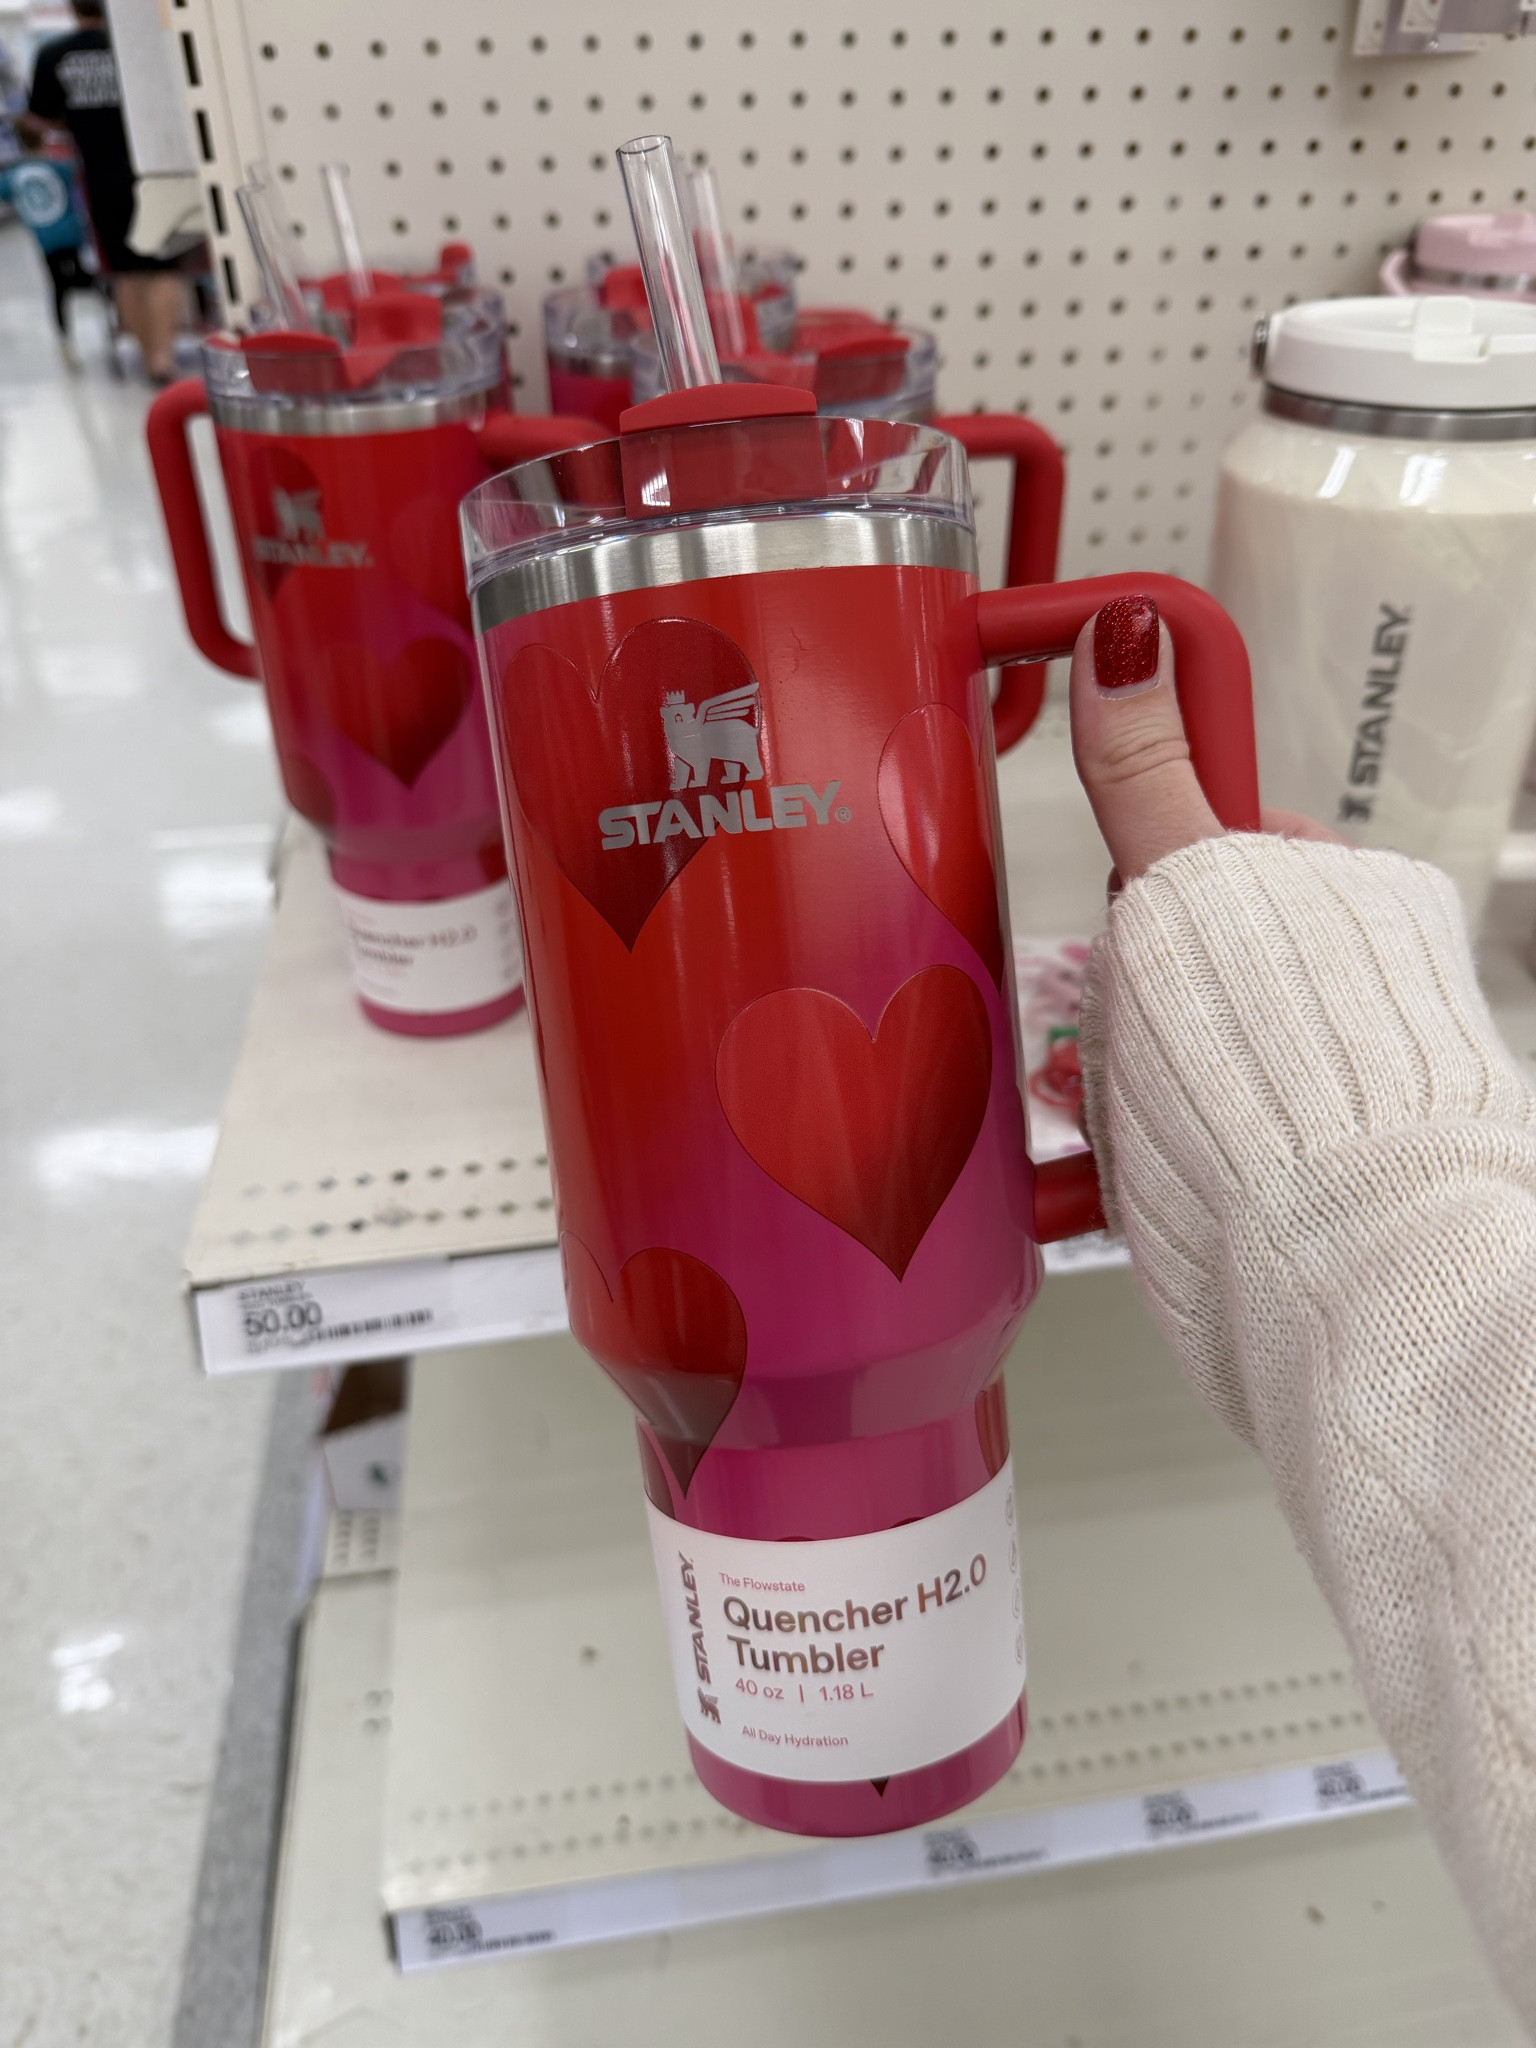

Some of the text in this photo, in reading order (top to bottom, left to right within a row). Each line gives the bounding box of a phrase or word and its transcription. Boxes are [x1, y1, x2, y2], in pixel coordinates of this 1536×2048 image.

[1348, 602, 1411, 787] STANLEY
[246, 1301, 323, 1337] 50.00
[719, 1572, 806, 1593] The Flowstate
[723, 1553, 987, 1634] Quencher H2.0
[678, 1550, 711, 1685] STANLEY
[727, 1634, 885, 1674] Tumbler
[735, 1677, 758, 1696] 40
[763, 1686, 785, 1700] oz
[819, 1683, 855, 1701] 1.18
[860, 1682, 874, 1698] L
[742, 1725, 849, 1748] All Day Hydration
